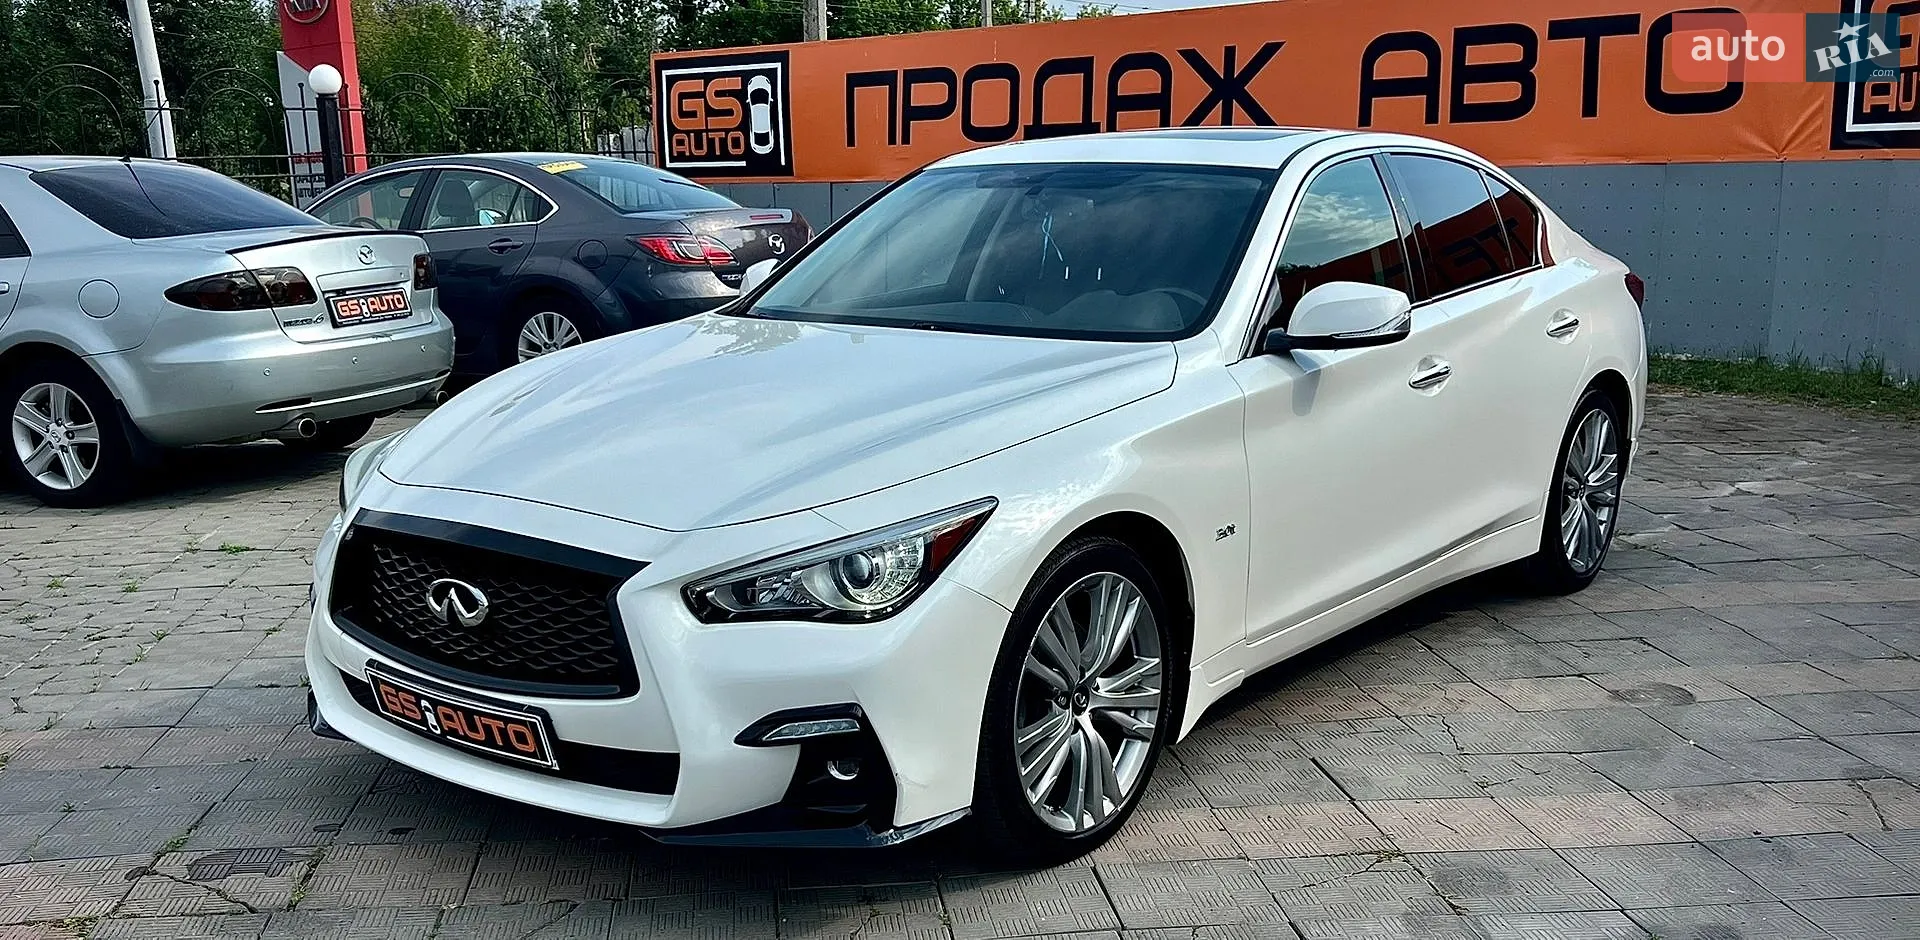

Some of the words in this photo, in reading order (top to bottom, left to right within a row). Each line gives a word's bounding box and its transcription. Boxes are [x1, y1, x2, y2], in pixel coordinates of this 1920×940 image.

[1870, 0, 1920, 68] G
[670, 77, 743, 131] GS
[845, 40, 1287, 149] ПРОДАЖ
[1356, 7, 1749, 129] АВТО
[1862, 71, 1920, 113] AU
[672, 130, 745, 157] AUTO
[336, 299, 361, 317] GS
[367, 293, 405, 313] AUTO
[379, 683, 422, 720] GS
[436, 705, 536, 753] AUTO
